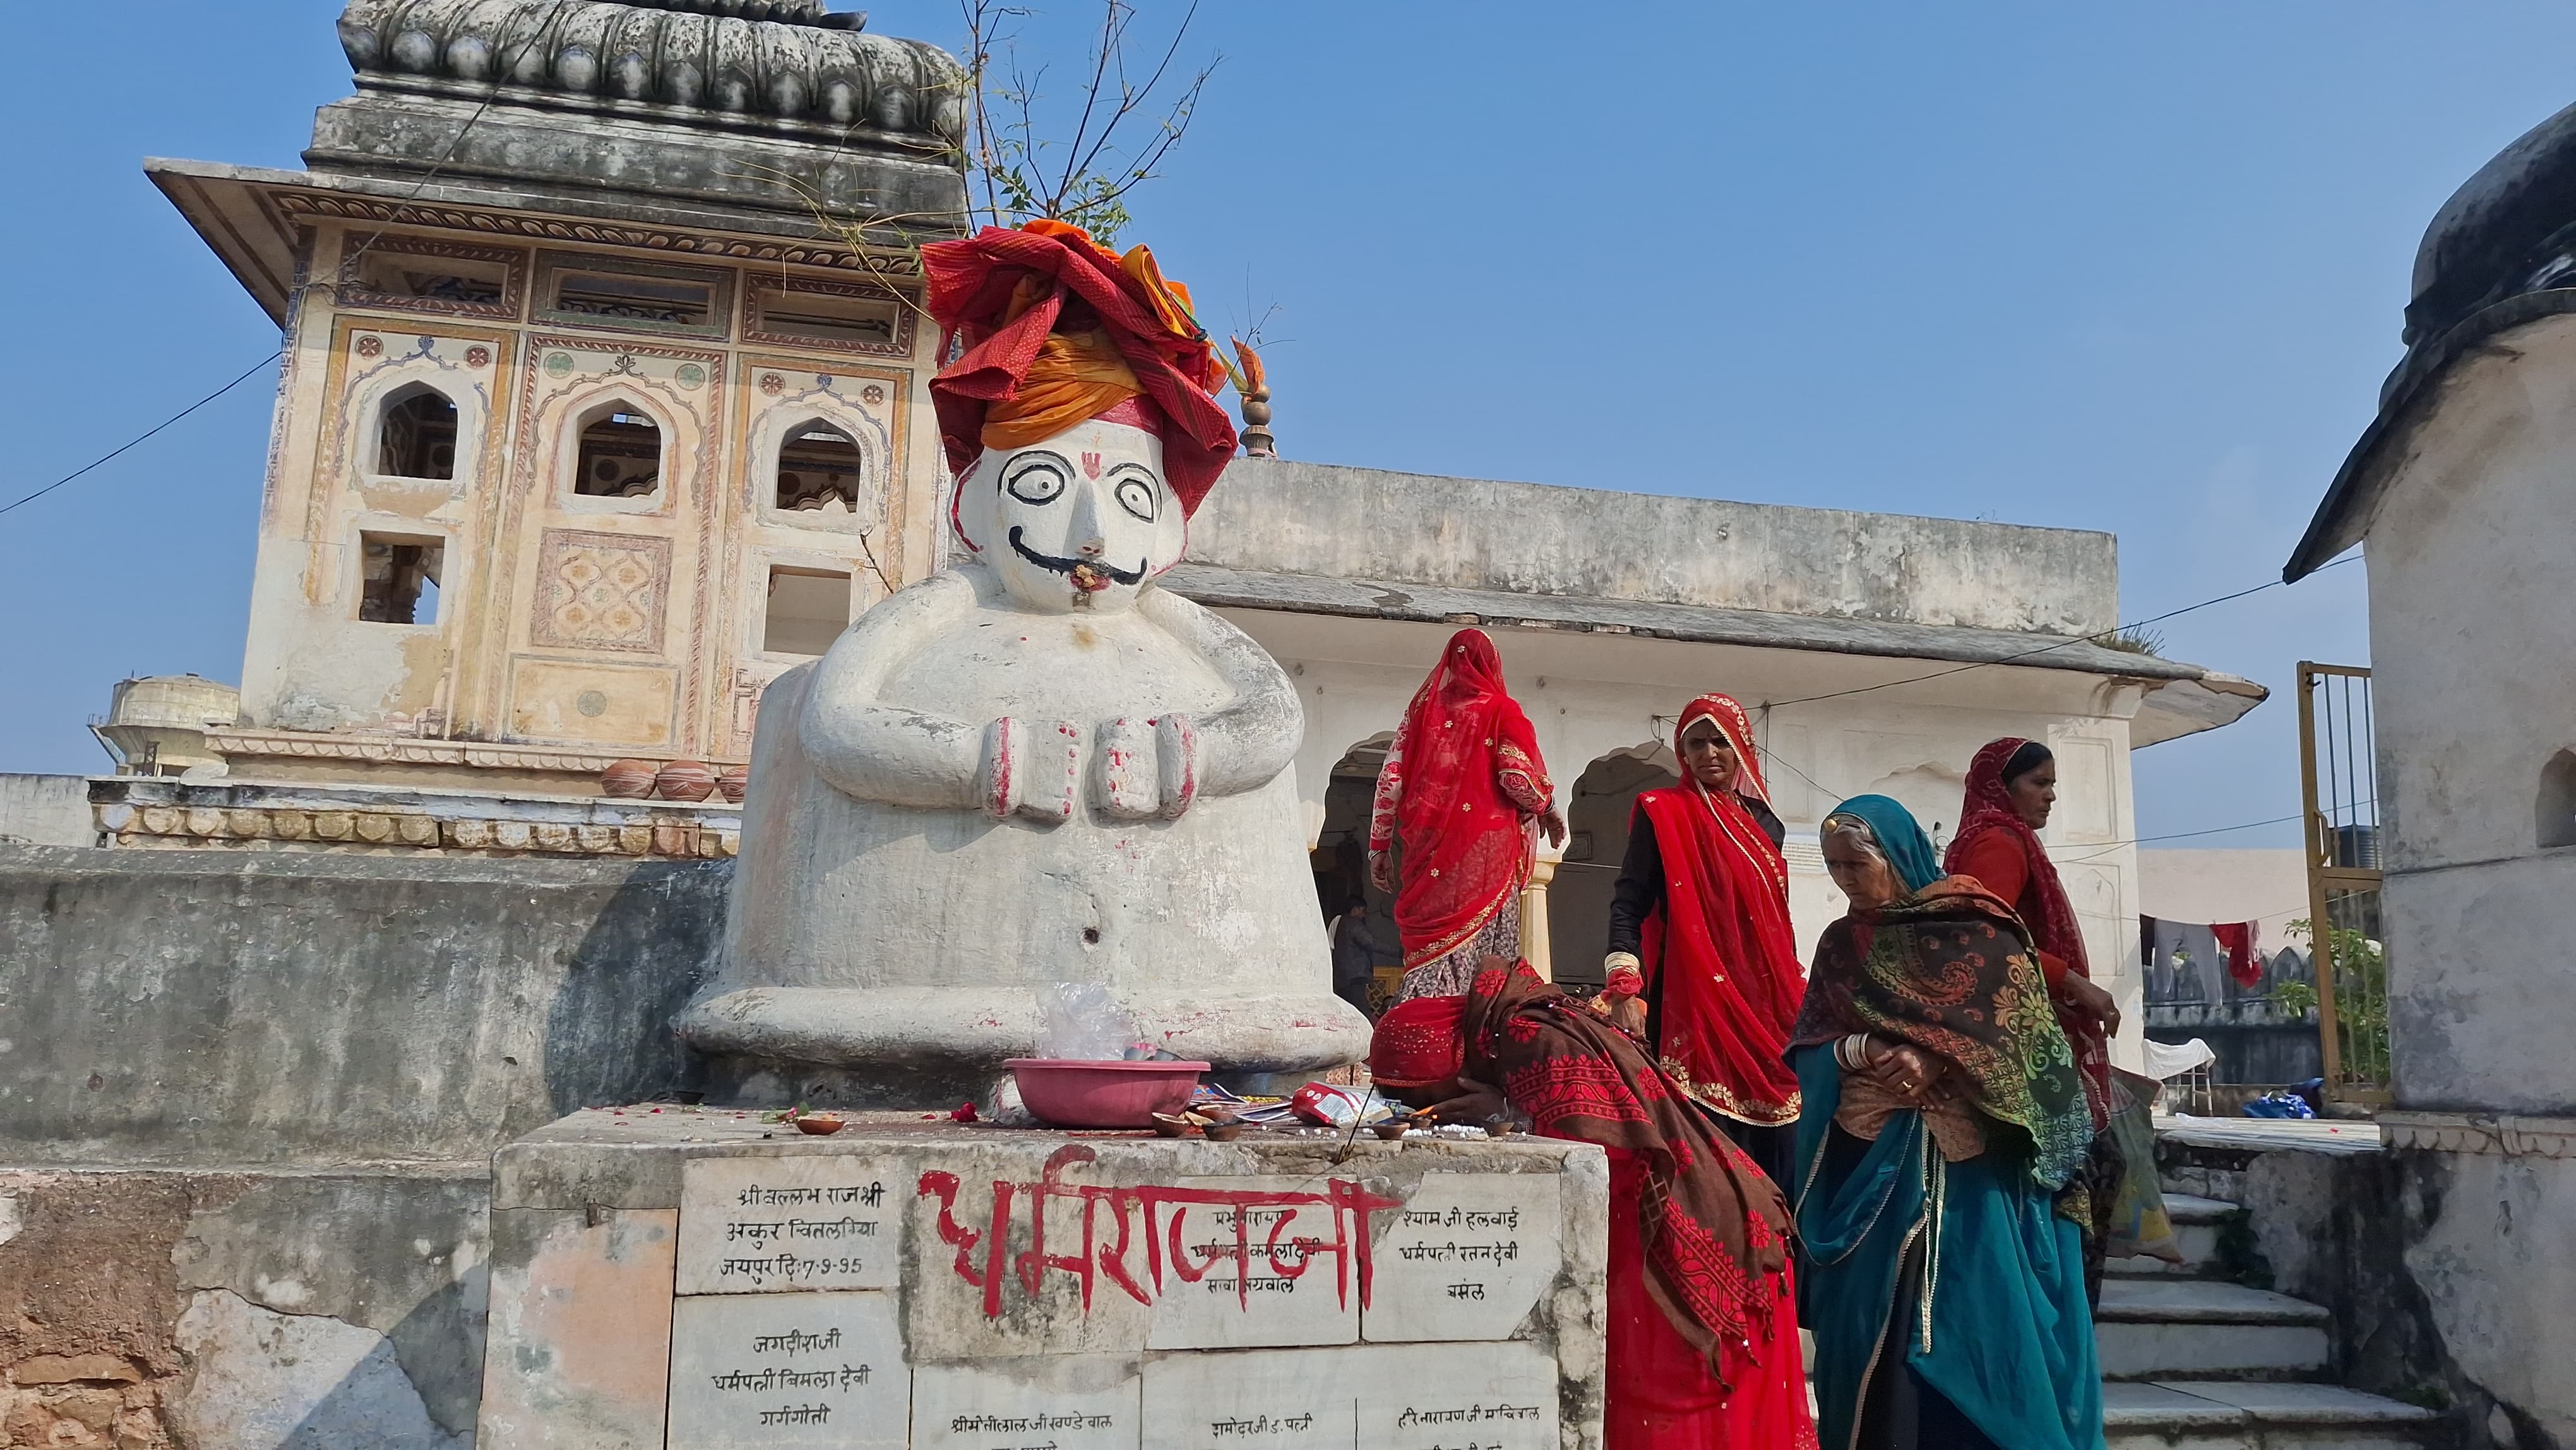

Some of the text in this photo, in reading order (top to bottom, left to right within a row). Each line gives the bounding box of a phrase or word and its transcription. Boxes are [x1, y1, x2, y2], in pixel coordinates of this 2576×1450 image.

[1403, 1206, 1519, 1231] श्याम जी हलवाई
[1460, 1247, 1491, 1262] रतन
[1494, 1241, 1518, 1267] देवी
[719, 1258, 774, 1285] जयपुर
[840, 1363, 872, 1394] देवी
